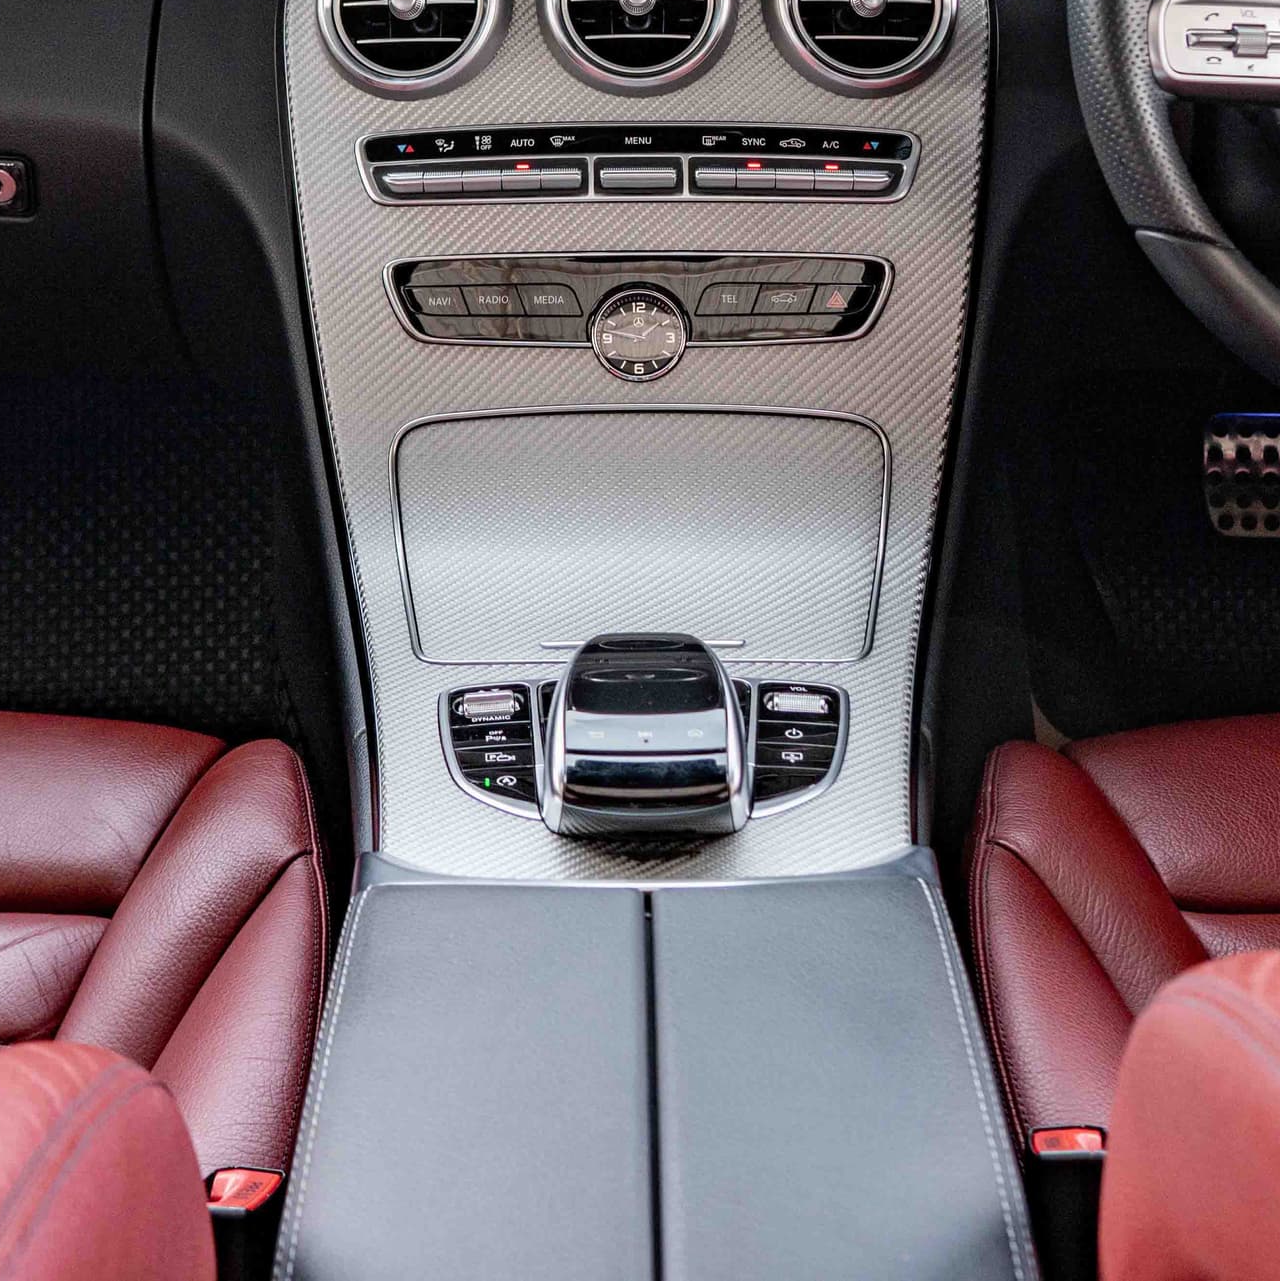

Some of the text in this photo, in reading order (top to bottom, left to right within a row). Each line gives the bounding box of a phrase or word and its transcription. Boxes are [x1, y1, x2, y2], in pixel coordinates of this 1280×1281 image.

[510, 138, 536, 148] AUTO
[624, 136, 652, 145] MENU
[741, 137, 767, 147] SYNC
[822, 140, 840, 150] A/C
[428, 296, 452, 307] NAVI
[478, 294, 510, 305] RADIO
[533, 294, 565, 306] MEDIA
[721, 294, 739, 304] TEL
[631, 301, 646, 314] 12
[602, 332, 613, 345] 9
[665, 331, 676, 344] 3
[633, 362, 645, 375] 6
[789, 685, 809, 693] VOL
[471, 714, 512, 723] DYNAMIC
